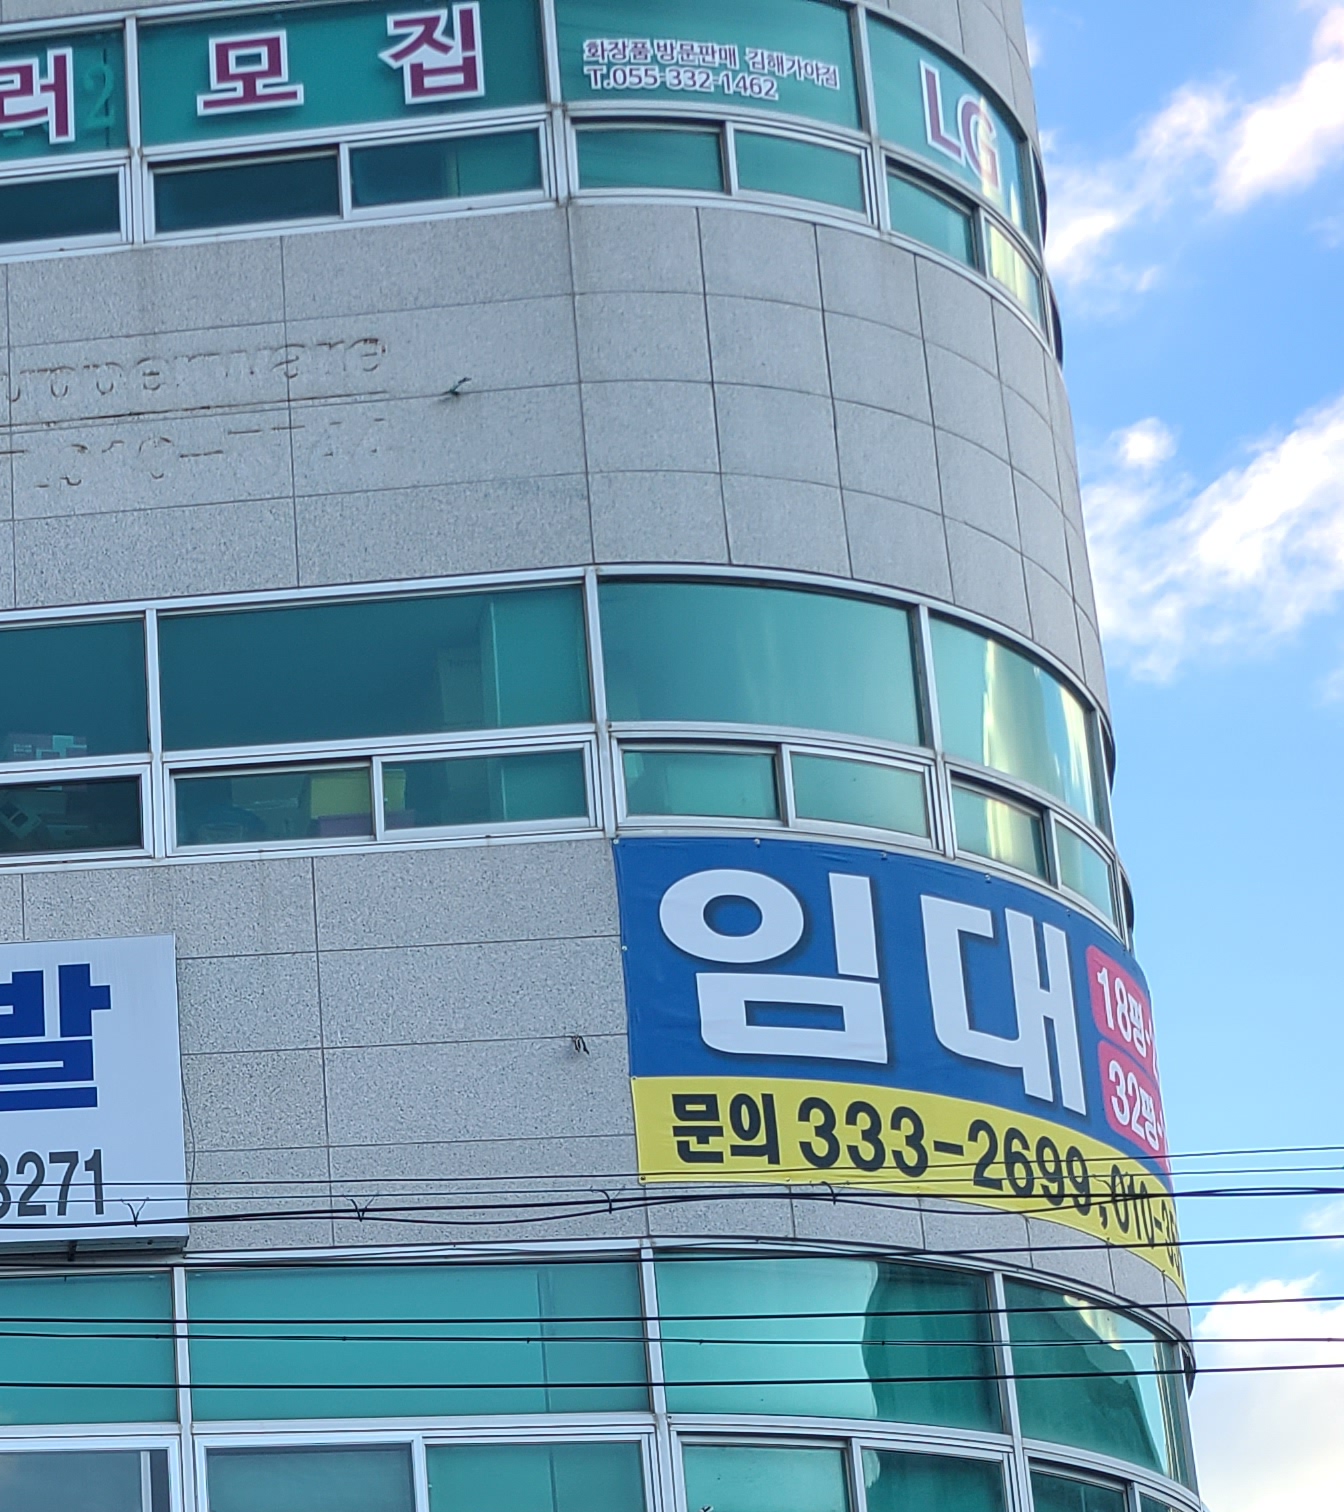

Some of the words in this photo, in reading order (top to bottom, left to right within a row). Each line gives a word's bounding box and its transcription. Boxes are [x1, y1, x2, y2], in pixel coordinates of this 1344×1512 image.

[583, 66, 779, 100] T.055-332-1462
[584, 38, 653, 64] 화장품
[654, 41, 739, 70] 방문판매
[919, 60, 1000, 188] LG
[659, 868, 1087, 1115] 임대
[671, 1092, 780, 1166] 문의
